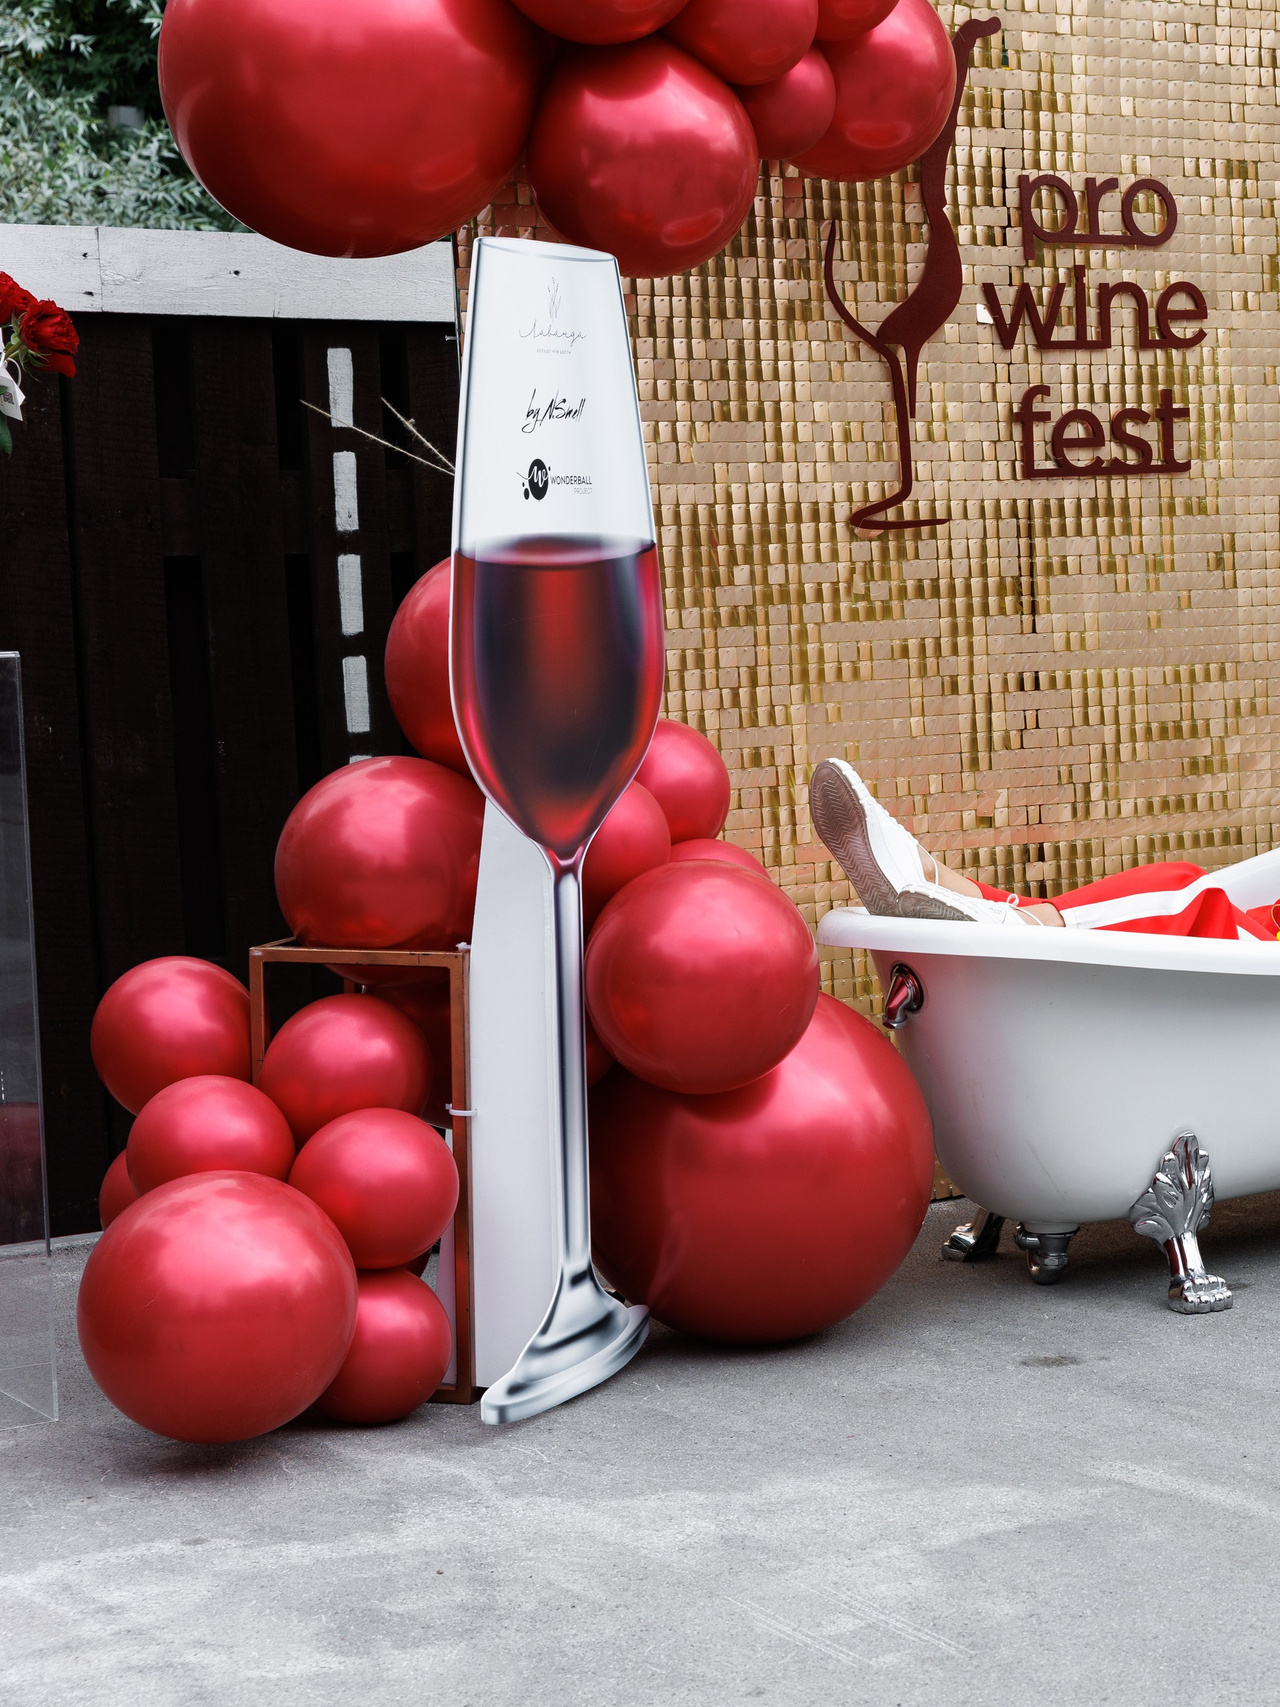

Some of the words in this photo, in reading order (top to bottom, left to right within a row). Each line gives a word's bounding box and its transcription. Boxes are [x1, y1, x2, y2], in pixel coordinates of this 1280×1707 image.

[1018, 174, 1178, 261] pro
[981, 264, 1209, 351] wine
[521, 388, 541, 433] by
[1014, 384, 1192, 479] fest
[550, 475, 593, 485] WONDERBALL
[573, 487, 593, 495] PROJECT
